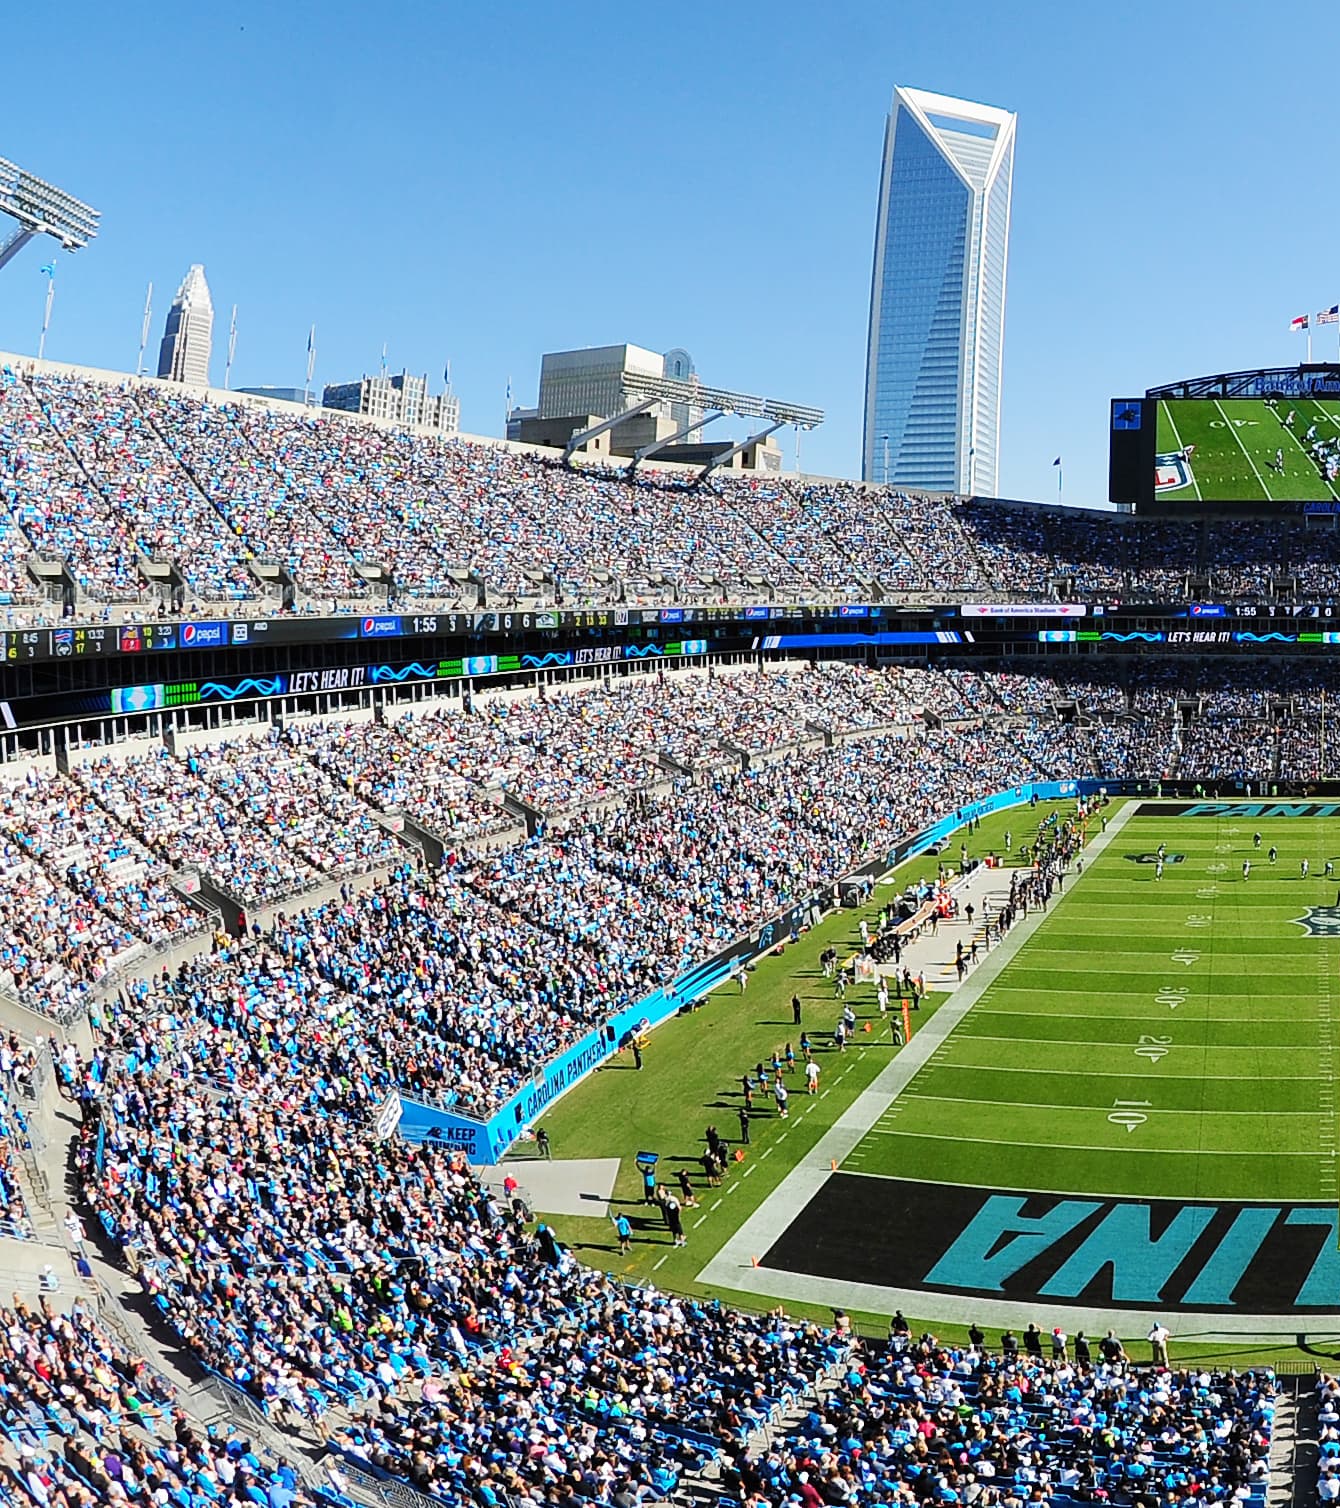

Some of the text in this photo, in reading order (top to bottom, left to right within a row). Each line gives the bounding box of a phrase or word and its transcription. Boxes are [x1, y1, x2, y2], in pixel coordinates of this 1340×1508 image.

[1255, 376, 1299, 392] Bank
[1300, 377, 1314, 393] of
[1235, 606, 1256, 616] 1:55
[376, 620, 396, 633] pepsi
[413, 617, 437, 633] 1:55
[504, 614, 512, 629] 6
[522, 614, 530, 628] 6
[196, 626, 220, 642] pepsi
[1167, 631, 1230, 643] LET'S HEAR IT!
[289, 666, 365, 692] LET'S HEAR IT!
[1154, 986, 1189, 1004] 30
[1134, 1035, 1173, 1057] 20
[527, 1033, 607, 1118] CAROLINA PANTHERS
[1107, 1098, 1153, 1124] 10
[447, 1127, 476, 1141] KEEP
